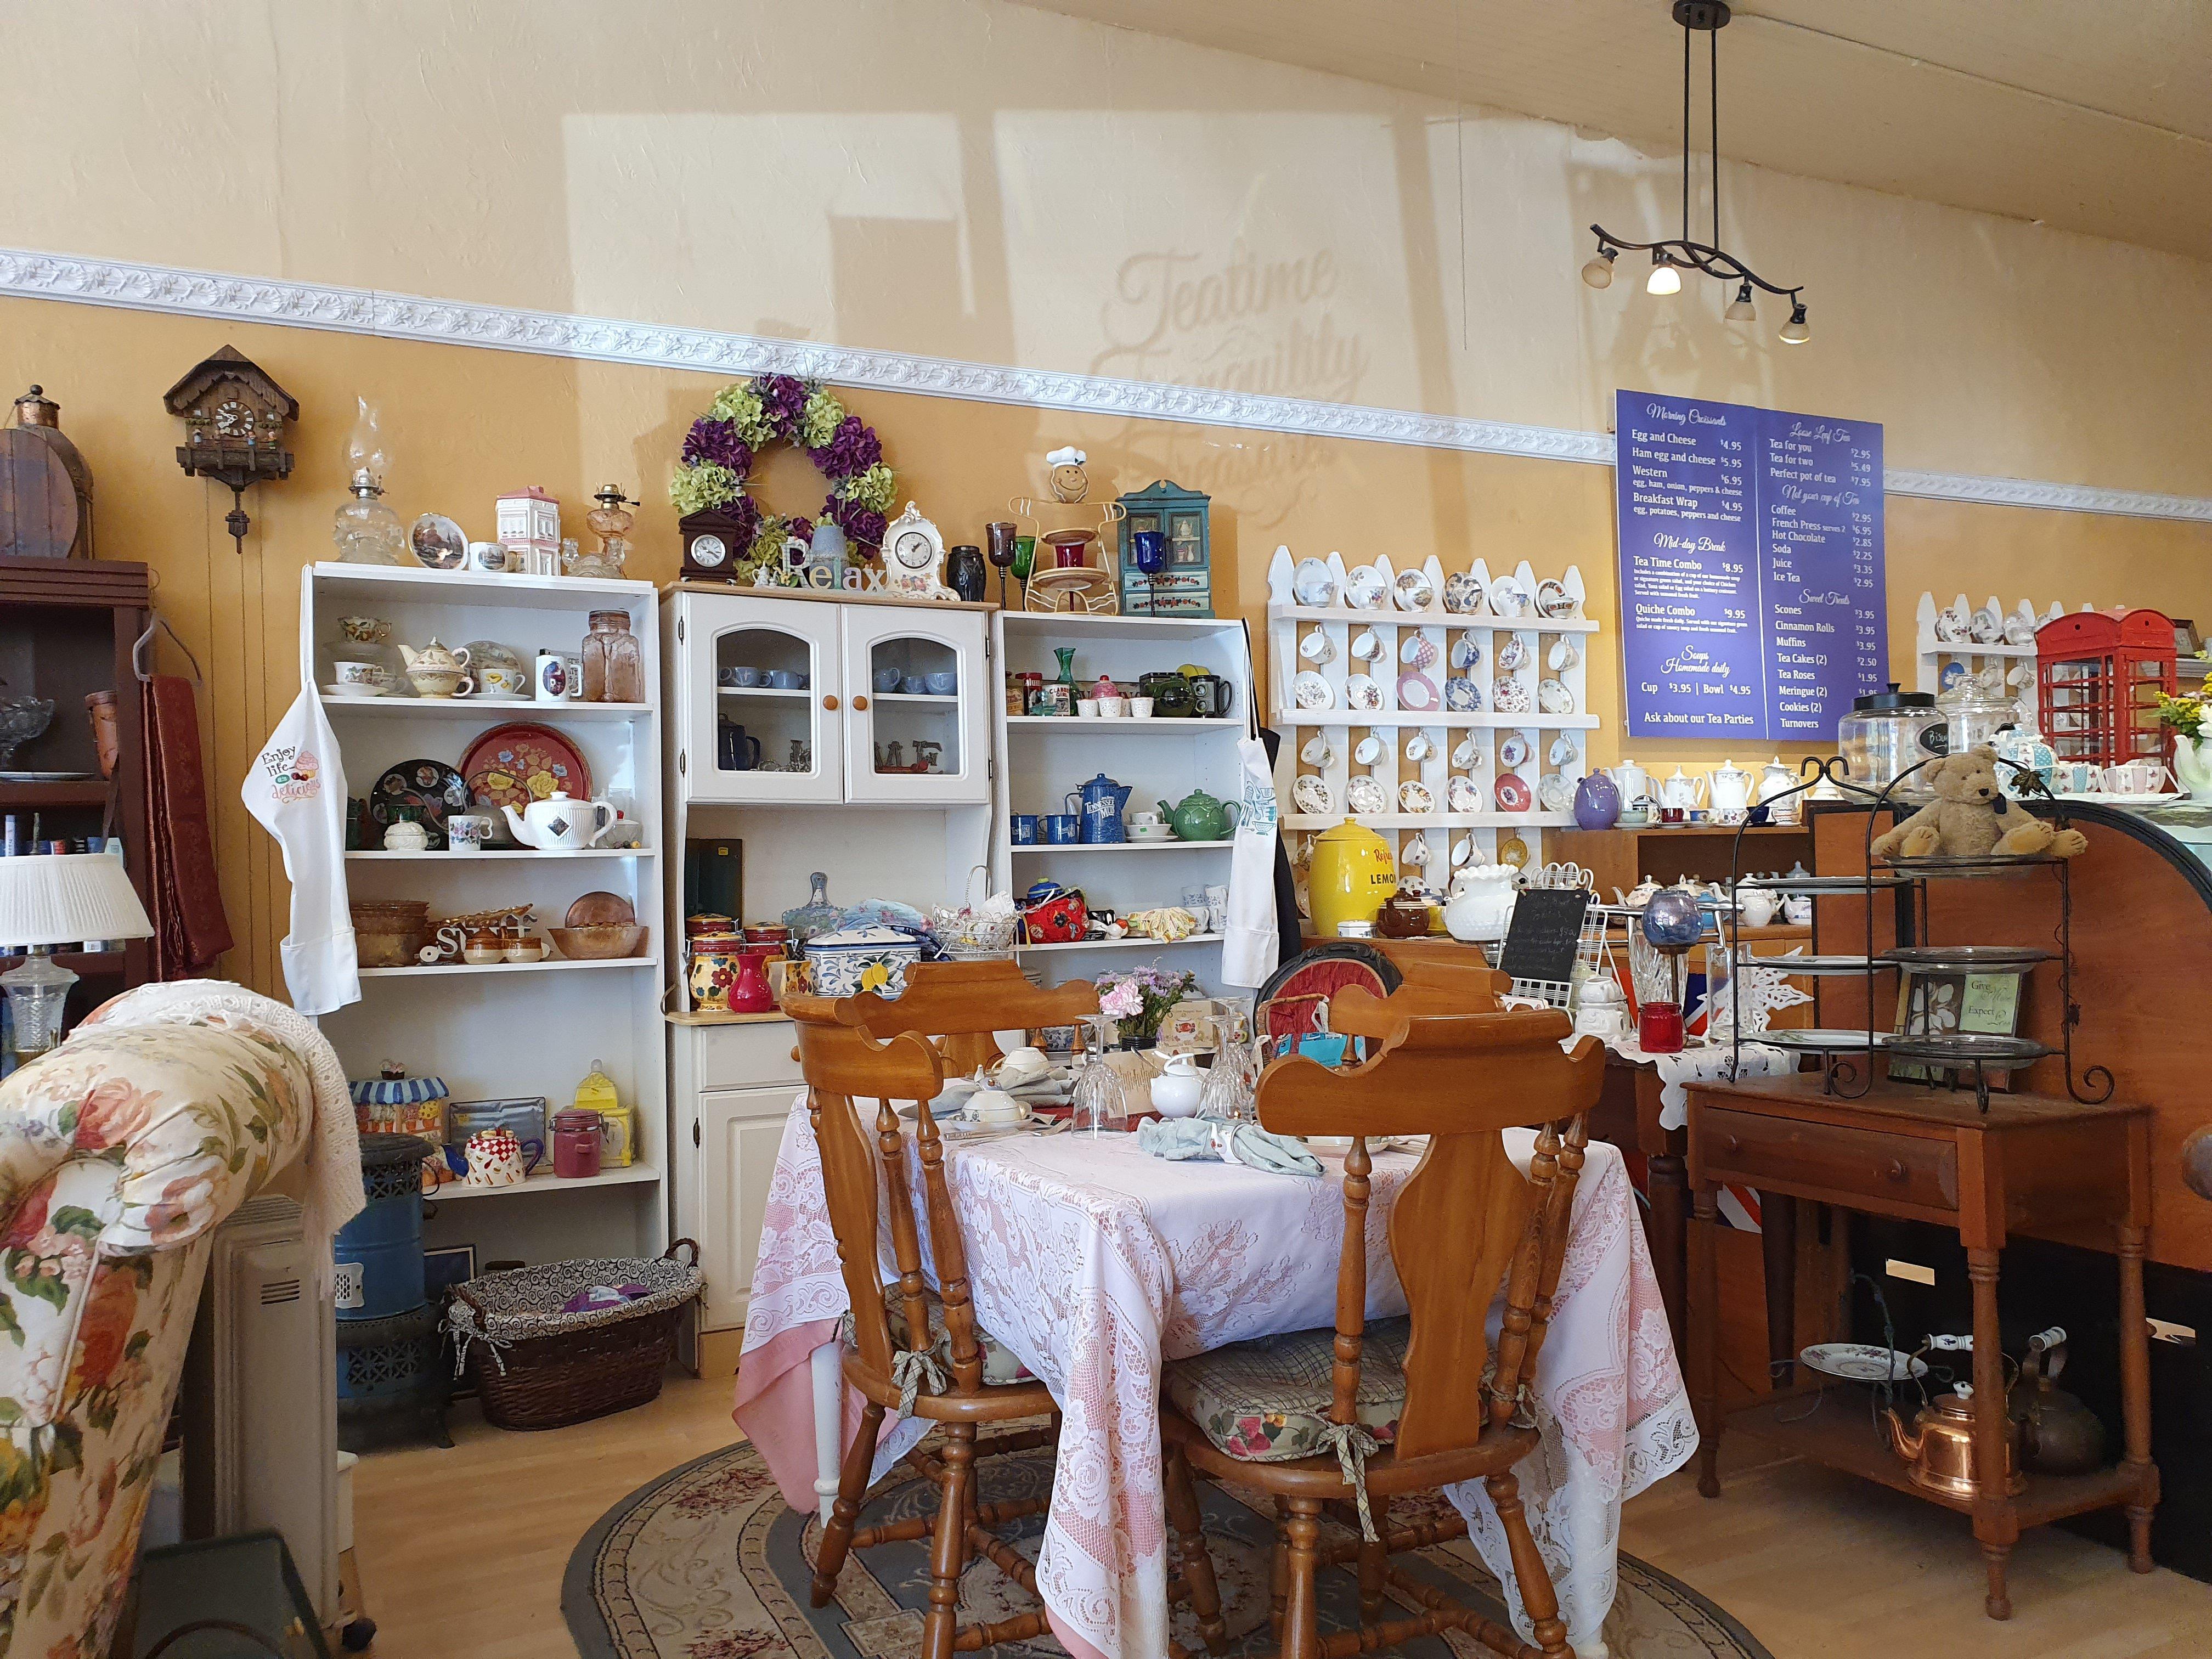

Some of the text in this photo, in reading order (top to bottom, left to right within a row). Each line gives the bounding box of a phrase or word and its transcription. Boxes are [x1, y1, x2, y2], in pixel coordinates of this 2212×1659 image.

[1646, 403, 1686, 426] Morning
[1632, 429, 1741, 450] Egg and Cheese $4.95
[1632, 447, 1742, 467] Ham egg and cheese $5.95
[1769, 439, 1871, 459] Tea for you $2.95
[1769, 453, 1783, 462] Tea
[1785, 454, 1796, 464] for
[1798, 457, 1814, 466] two
[1633, 465, 1742, 486] Western $6.95
[1770, 467, 1871, 487] Perfect pot of tea $7.95
[1649, 480, 1665, 489] ham,
[1689, 485, 1714, 494] peppers
[1722, 487, 1742, 496] cheese
[1633, 493, 1742, 511] Breakfast Wrap $4.95
[1650, 507, 1679, 517] potatoes,
[1681, 511, 1706, 519] peppers
[1720, 513, 1741, 522] cheese
[1771, 505, 1871, 523] Coffee $2.95
[1772, 518, 1798, 528] French
[1801, 520, 1821, 531] Press
[1853, 525, 1871, 535] $6.95
[1654, 533, 1726, 554] Mid-day Break
[1772, 530, 1872, 548] Hot Chocolate $2.85
[1773, 544, 1872, 560] Soda $2.25
[779, 537, 887, 592] Relax
[1633, 556, 1743, 573] Tea Time Combo $8.95
[1773, 557, 1873, 574] Juice $3.35
[1774, 572, 1874, 588] Ice Tea $2.95
[1636, 603, 1745, 619] Quiche Combo $9.95
[1775, 604, 1874, 619] Scones $3.95
[1776, 621, 1875, 635] Cinnamon Rolls $3.95
[1777, 637, 1876, 651] Muffins $3.95
[1681, 645, 1709, 663] Soups
[1777, 653, 1876, 667] Tea Cakes (2) $2.50
[1661, 658, 1731, 678] Homemade daily
[1778, 669, 1877, 682] Tea Roses $1.95
[1641, 682, 1657, 695] Cup
[1669, 682, 1691, 693] $3.95
[1703, 684, 1724, 694] Bowl
[1730, 685, 1751, 695] $4.95
[1779, 686, 1815, 697] Meringue
[1816, 687, 1827, 698] (2)
[1780, 702, 1821, 713] Cookies (2)
[1644, 712, 1661, 722] Ask
[1663, 713, 1688, 723] about
[1707, 713, 1722, 724] Tea
[1724, 714, 1754, 724] Parties
[1780, 718, 1819, 728] Turnovers
[261, 746, 296, 765] Enjoy
[272, 779, 321, 799] delicious
[1085, 799, 1114, 814] TENNESSEE
[1100, 808, 1115, 819] MUD
[1971, 980, 1990, 990] Give
[1968, 1006, 1994, 1017] Expect
